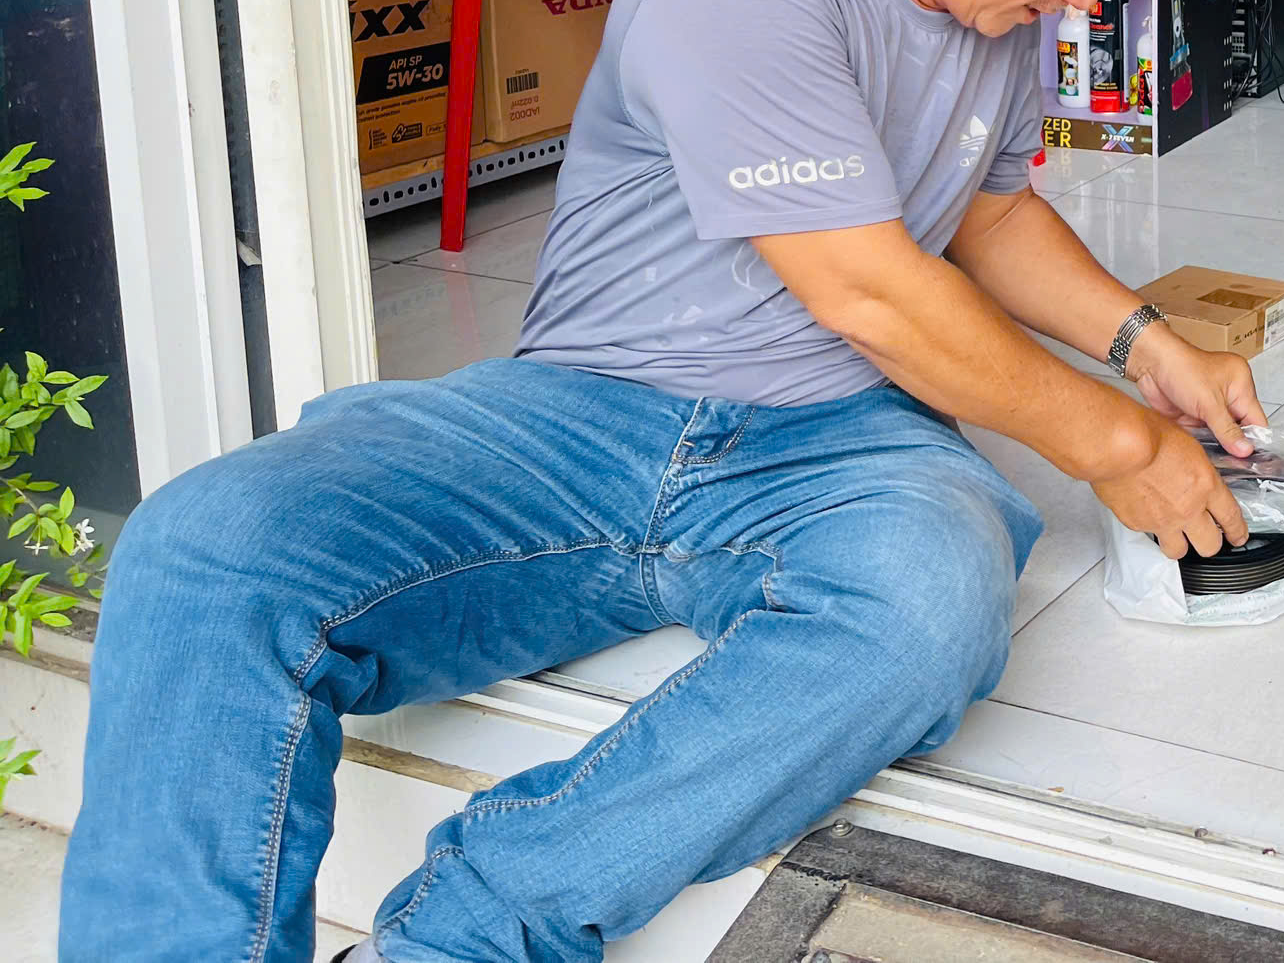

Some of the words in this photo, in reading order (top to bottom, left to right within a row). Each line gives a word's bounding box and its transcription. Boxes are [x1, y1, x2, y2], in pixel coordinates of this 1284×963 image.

[386, 63, 444, 90] 5W-30
[389, 58, 408, 71] API
[409, 55, 423, 67] SP
[728, 155, 865, 189] adidas
